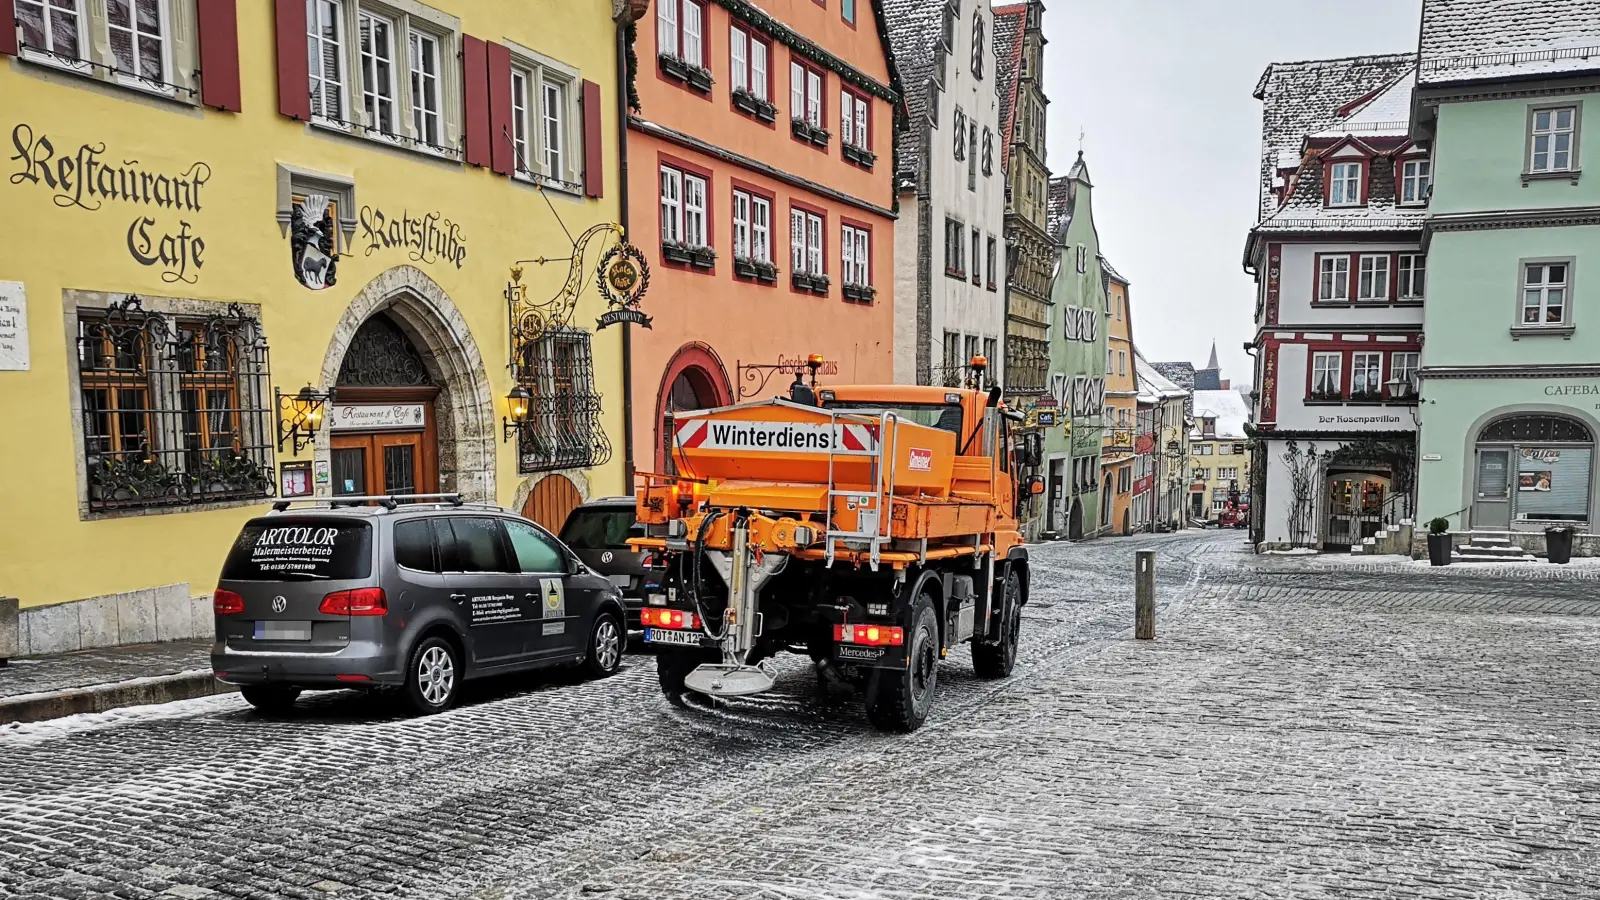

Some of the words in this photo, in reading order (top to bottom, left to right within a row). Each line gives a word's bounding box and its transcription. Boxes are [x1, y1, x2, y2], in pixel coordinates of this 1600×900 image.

[127, 216, 205, 284] Cafe
[778, 354, 838, 376] Geschehaus
[342, 406, 384, 419] Restaurant
[1318, 415, 1335, 424] Der
[1336, 414, 1400, 425] Rosenpavillon
[712, 424, 838, 449] Winterdienst
[1522, 447, 1560, 459] Coffee
[256, 527, 338, 546] ARTCOLOR
[252, 545, 333, 557] Malermeisterbetrieb
[650, 629, 667, 641] ROT
[673, 631, 685, 643] AN
